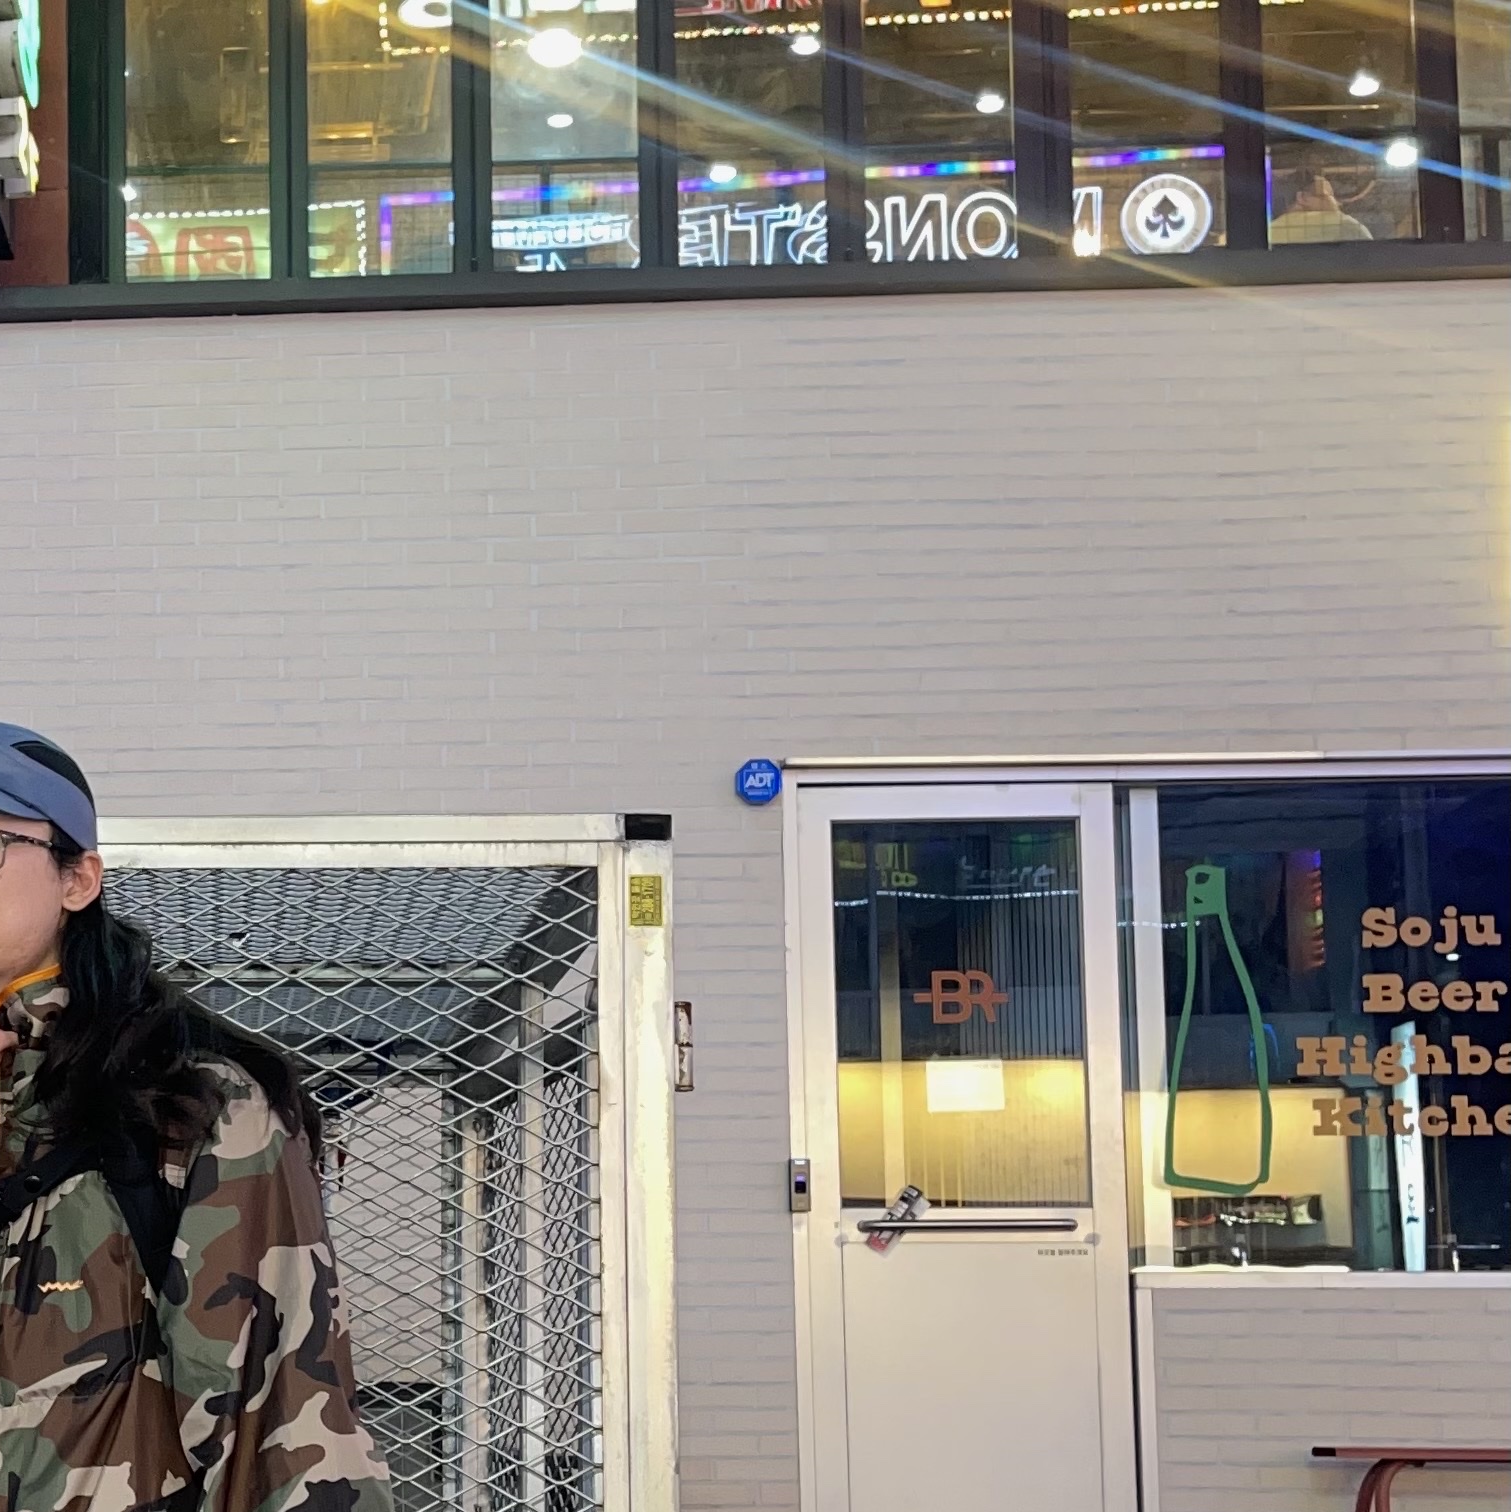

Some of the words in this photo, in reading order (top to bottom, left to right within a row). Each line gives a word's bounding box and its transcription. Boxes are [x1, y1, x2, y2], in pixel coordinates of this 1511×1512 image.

[744, 772, 775, 789] ADT
[1361, 905, 1502, 954] Soju
[931, 970, 996, 1024] BR
[1361, 973, 1508, 1013] Beer
